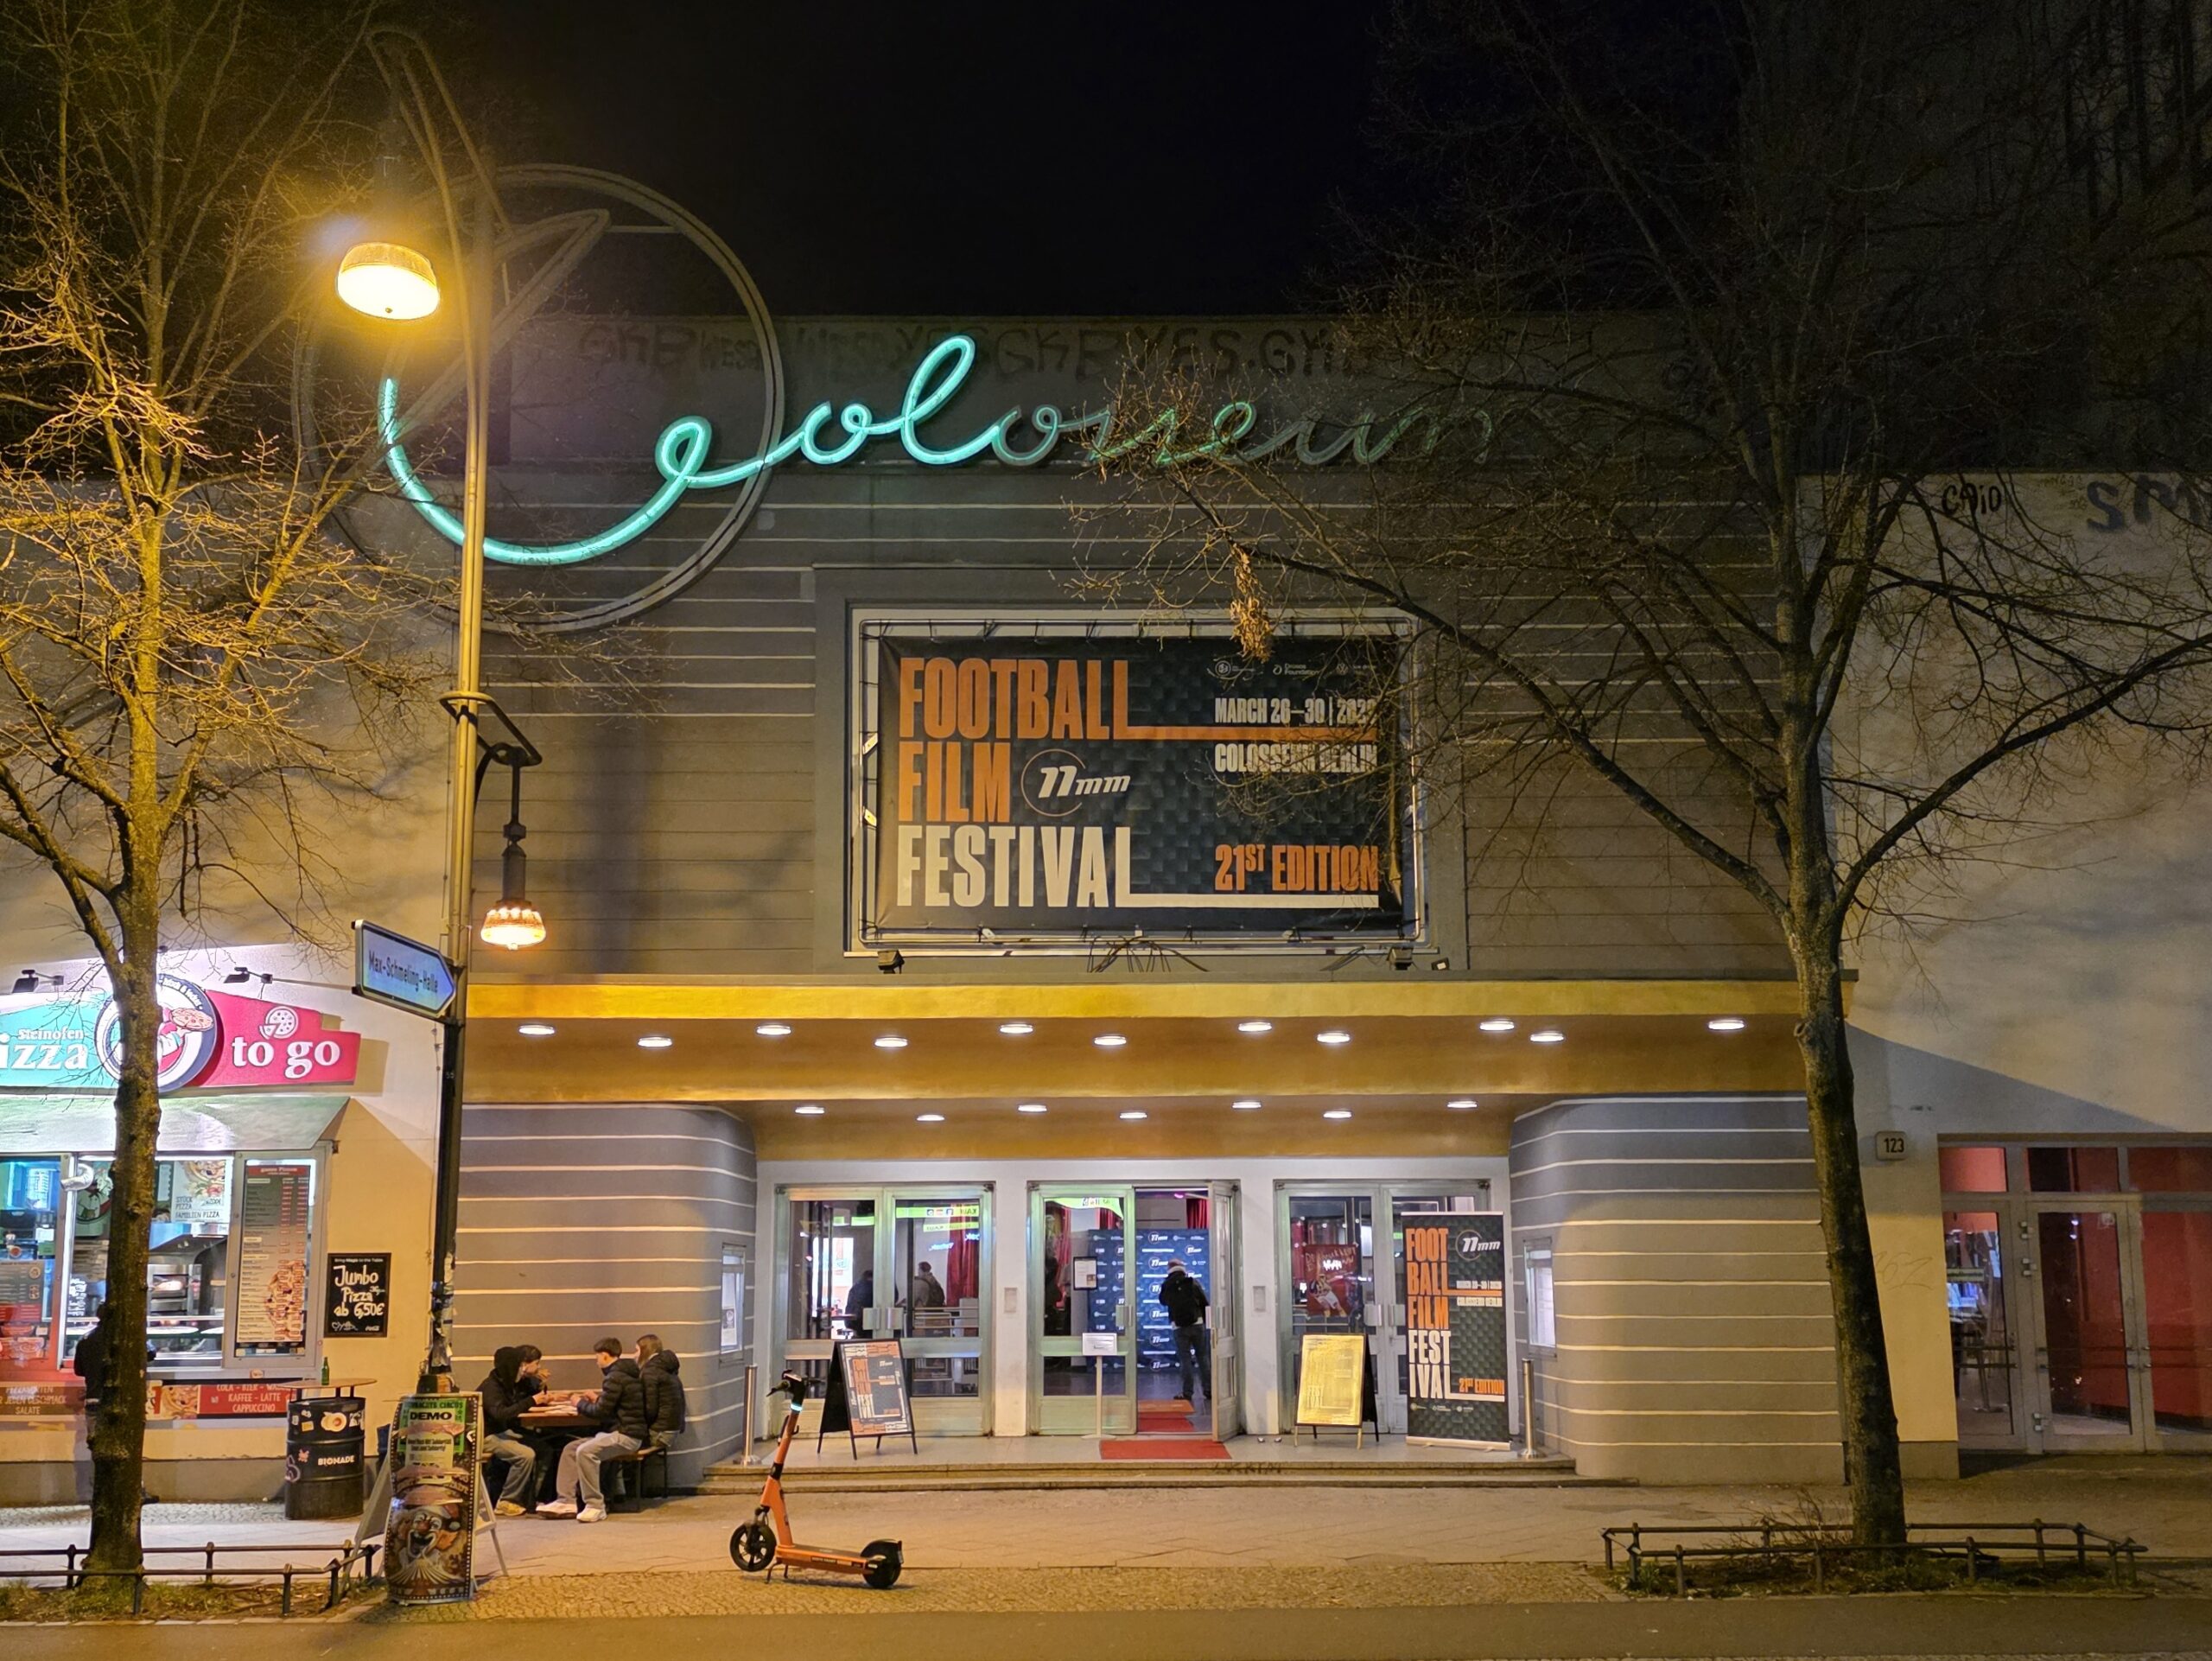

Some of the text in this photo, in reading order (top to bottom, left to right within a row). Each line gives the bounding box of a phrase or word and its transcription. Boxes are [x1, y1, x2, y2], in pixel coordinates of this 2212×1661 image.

[898, 656, 1151, 741] FOOTBALL
[1214, 697, 1268, 724] MARCH
[898, 741, 1010, 822] FILM
[896, 824, 1149, 907] FESTIVAL
[1271, 845, 1380, 892] EDITION
[17, 1026, 84, 1041] Steinofen
[232, 1035, 340, 1079] to go
[1883, 1136, 1905, 1154] 123
[1405, 1227, 1449, 1263] FOOT
[333, 1263, 378, 1288] Jumbo
[1406, 1262, 1455, 1296] BALL
[340, 1286, 374, 1303] Pizza
[334, 1301, 385, 1319] ab 6,50€
[1408, 1296, 1450, 1330] FILM
[1408, 1329, 1452, 1365] FEST
[228, 1392, 281, 1402] KAFFEE LATTE
[1409, 1364, 1459, 1400] IVAL
[15, 1406, 41, 1415] SALATE
[232, 1403, 276, 1412] CAPPUCCINO
[410, 1411, 453, 1421] DEMO
